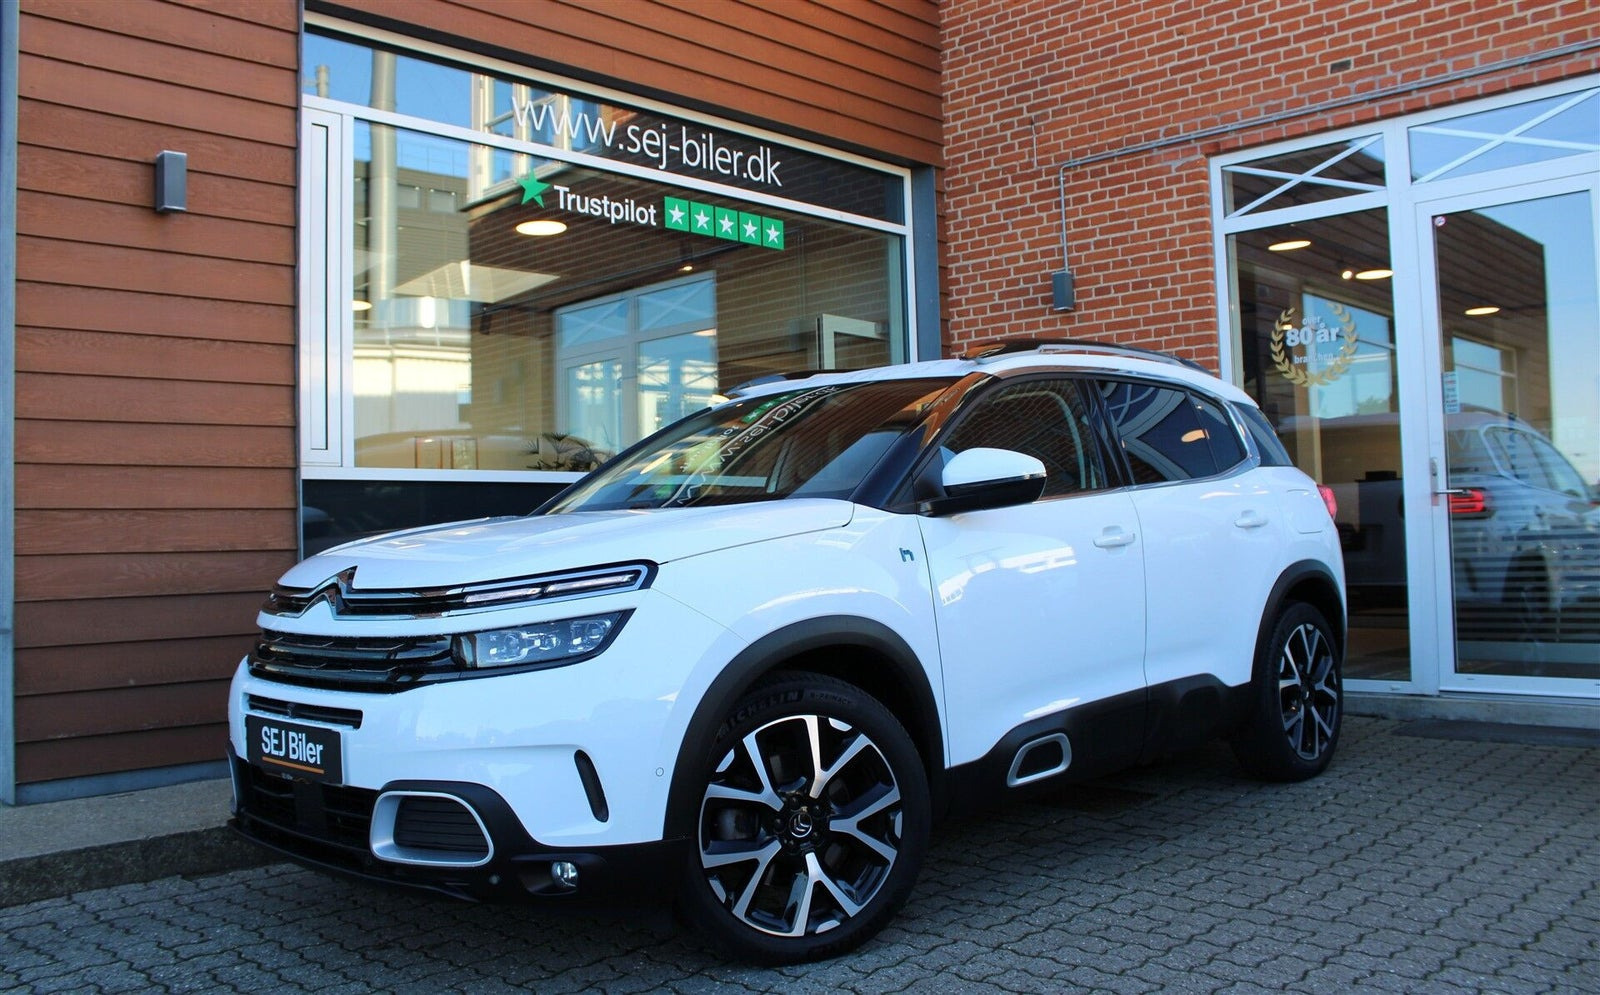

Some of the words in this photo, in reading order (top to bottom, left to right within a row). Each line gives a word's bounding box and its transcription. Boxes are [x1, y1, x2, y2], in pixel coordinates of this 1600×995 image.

[511, 96, 783, 188] www.sej-biler.dk
[554, 184, 657, 227] Trustpilot
[1286, 326, 1313, 347] 80
[1316, 322, 1340, 343] år
[261, 726, 285, 756] SEJ
[288, 731, 323, 764] Biler
